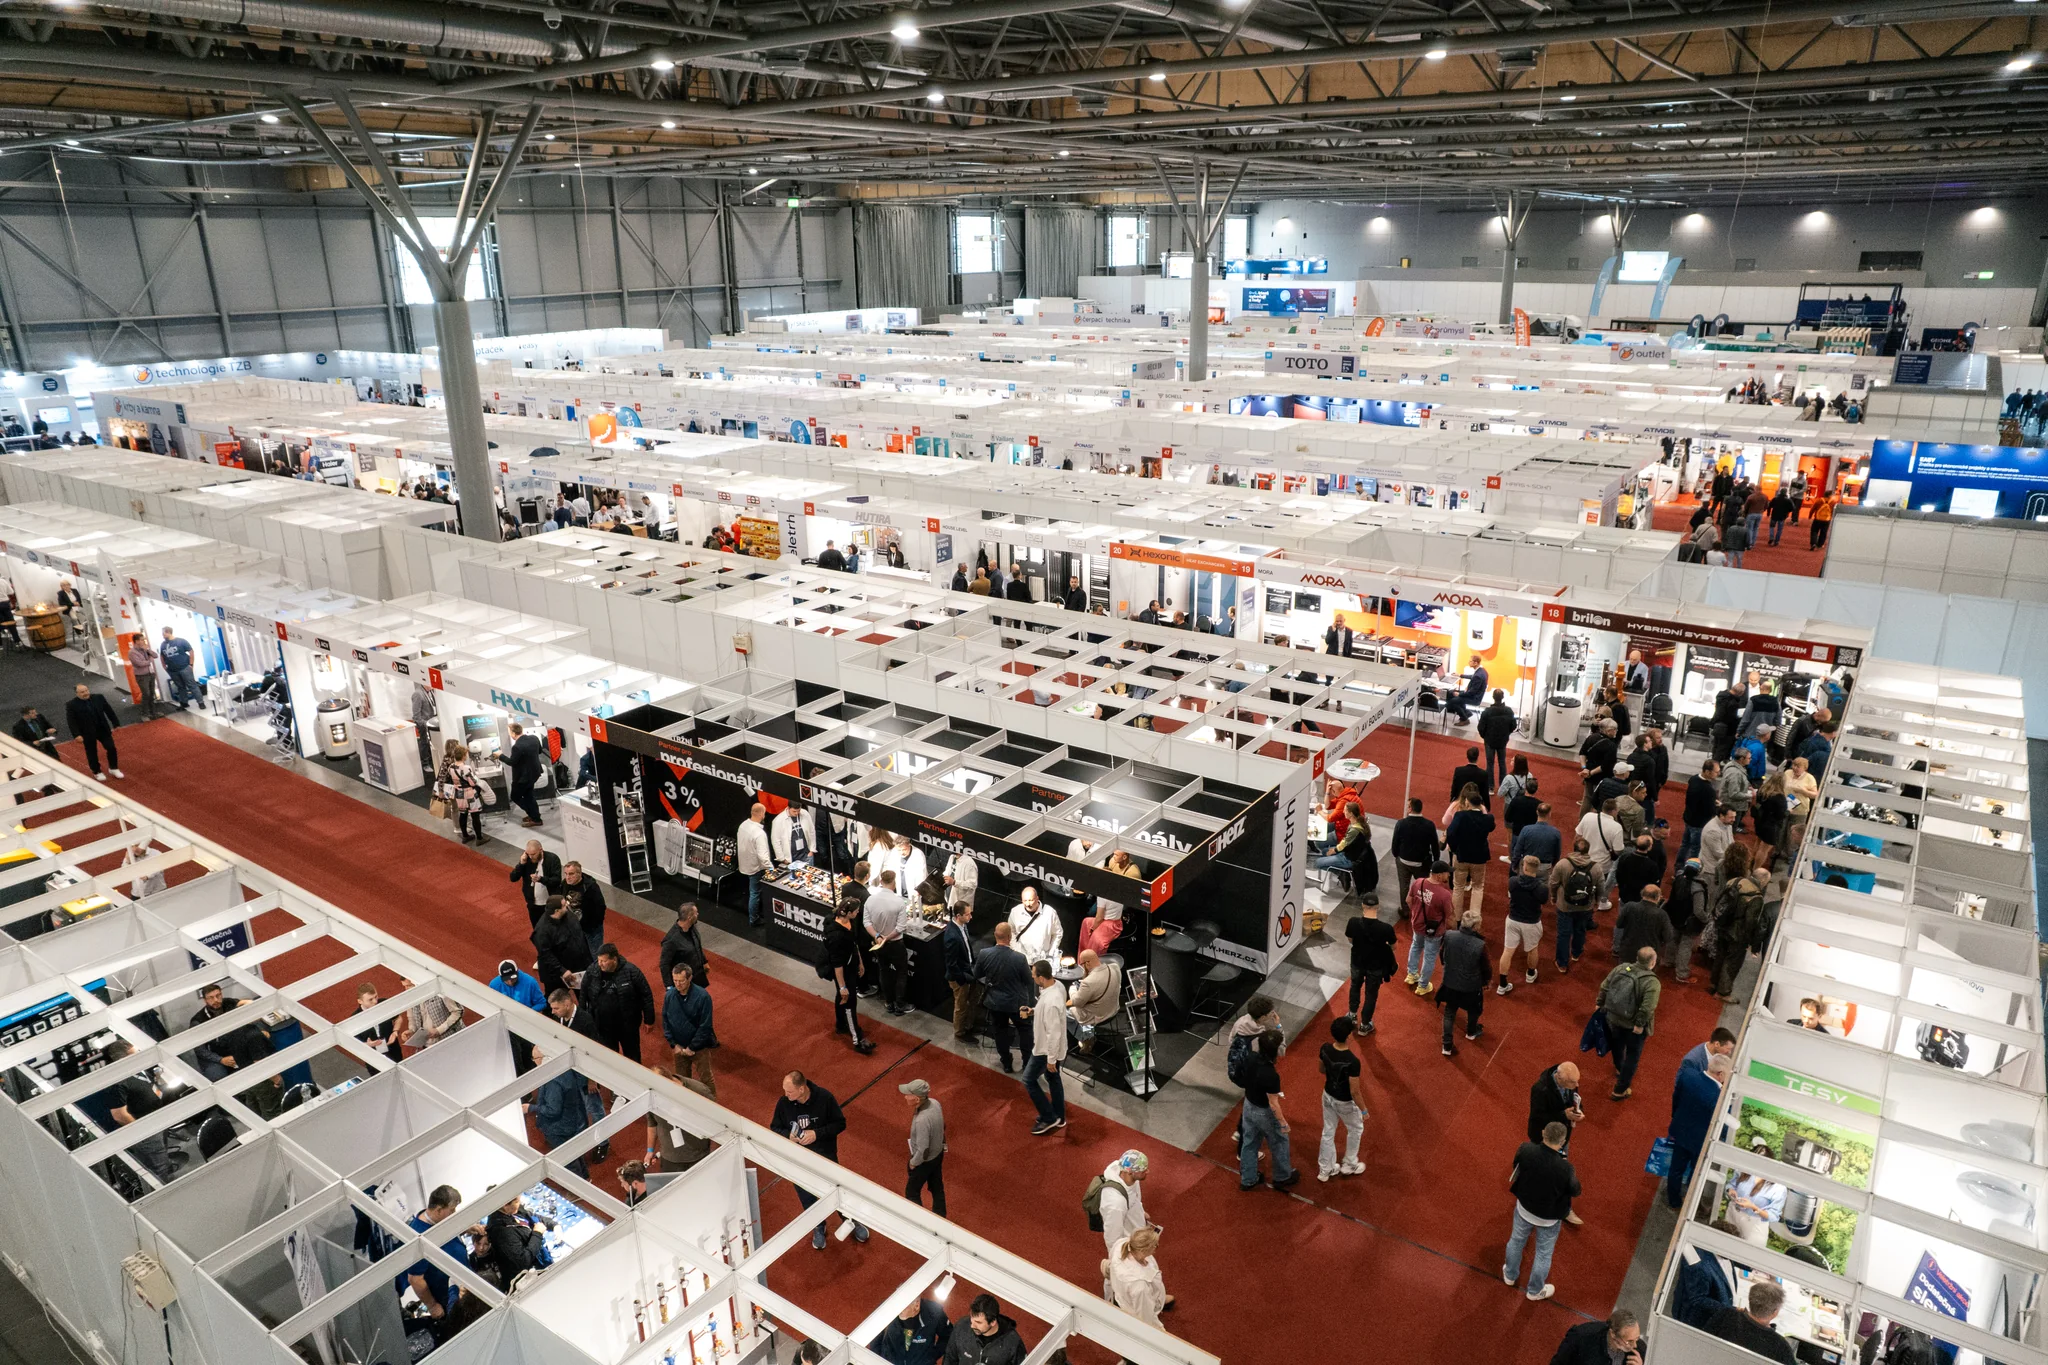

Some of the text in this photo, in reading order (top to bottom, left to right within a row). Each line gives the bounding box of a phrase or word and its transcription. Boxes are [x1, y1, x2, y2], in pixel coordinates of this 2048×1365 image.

[1106, 315, 1131, 324] technika
[1636, 350, 1665, 359] outlet
[156, 360, 253, 378] technologie TZB
[1285, 357, 1329, 370] TOTO
[123, 400, 137, 414] krby
[141, 402, 162, 416] kamna
[1538, 419, 1568, 427] ATMOS
[954, 432, 974, 440] Vaillant
[1643, 427, 1676, 435] ATMOS
[995, 435, 1015, 443] Vaillant
[1758, 435, 1792, 444] ATMOS
[321, 459, 338, 468] Haier
[855, 511, 892, 525] HUTIRA
[1113, 547, 1122, 555] 20
[1197, 559, 1226, 569] EXCHANGERS
[1241, 565, 1274, 576] 19 MORA
[1300, 574, 1346, 589] MORA
[170, 594, 196, 609] AFRISO
[1433, 592, 1484, 608] MORA
[226, 611, 256, 628] AFRISO
[1548, 609, 1807, 655] 18 brilon HYBRIDNÍ SYSTÉMY KRONOTERM
[1693, 655, 1729, 664] TEPELNÁ
[1746, 661, 1790, 672] VĚTRACÍ
[1397, 688, 1409, 703] RBM
[490, 689, 540, 718] HAKL
[467, 716, 494, 726] HAKL
[1361, 723, 1368, 732] AV
[658, 741, 680, 754] Partner
[659, 750, 764, 792] profesionály
[664, 781, 700, 809] 3 %
[1031, 785, 1066, 801] Partner
[571, 815, 595, 830] HAKL
[918, 819, 963, 840] Partner pre
[1281, 797, 1297, 899] veletrh
[919, 830, 1074, 890] profesionálov
[774, 918, 786, 929] PRO
[1784, 1075, 1848, 1104] TESY
[1919, 1272, 1957, 1317] Dodatečná
